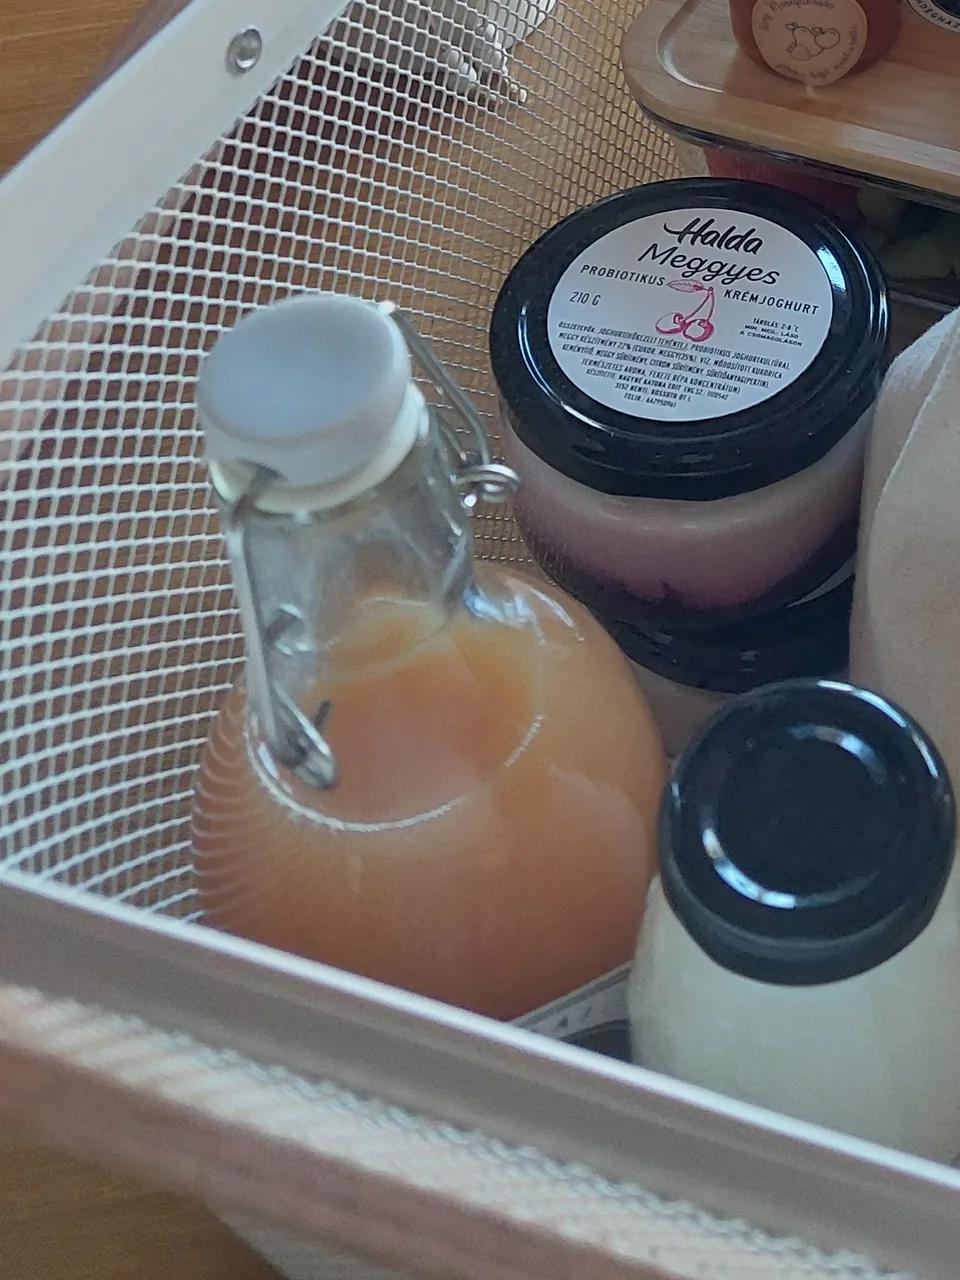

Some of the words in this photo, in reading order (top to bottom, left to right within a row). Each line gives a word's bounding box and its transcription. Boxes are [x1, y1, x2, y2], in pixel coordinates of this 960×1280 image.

[663, 218, 763, 255] Halda
[637, 243, 780, 285] Meggyes
[569, 291, 590, 304] 210
[592, 294, 601, 306] G
[580, 264, 666, 287] PROBIOTIKUS
[724, 288, 819, 315] KRÉMJOGHURT
[752, 366, 782, 379] KUKORICA
